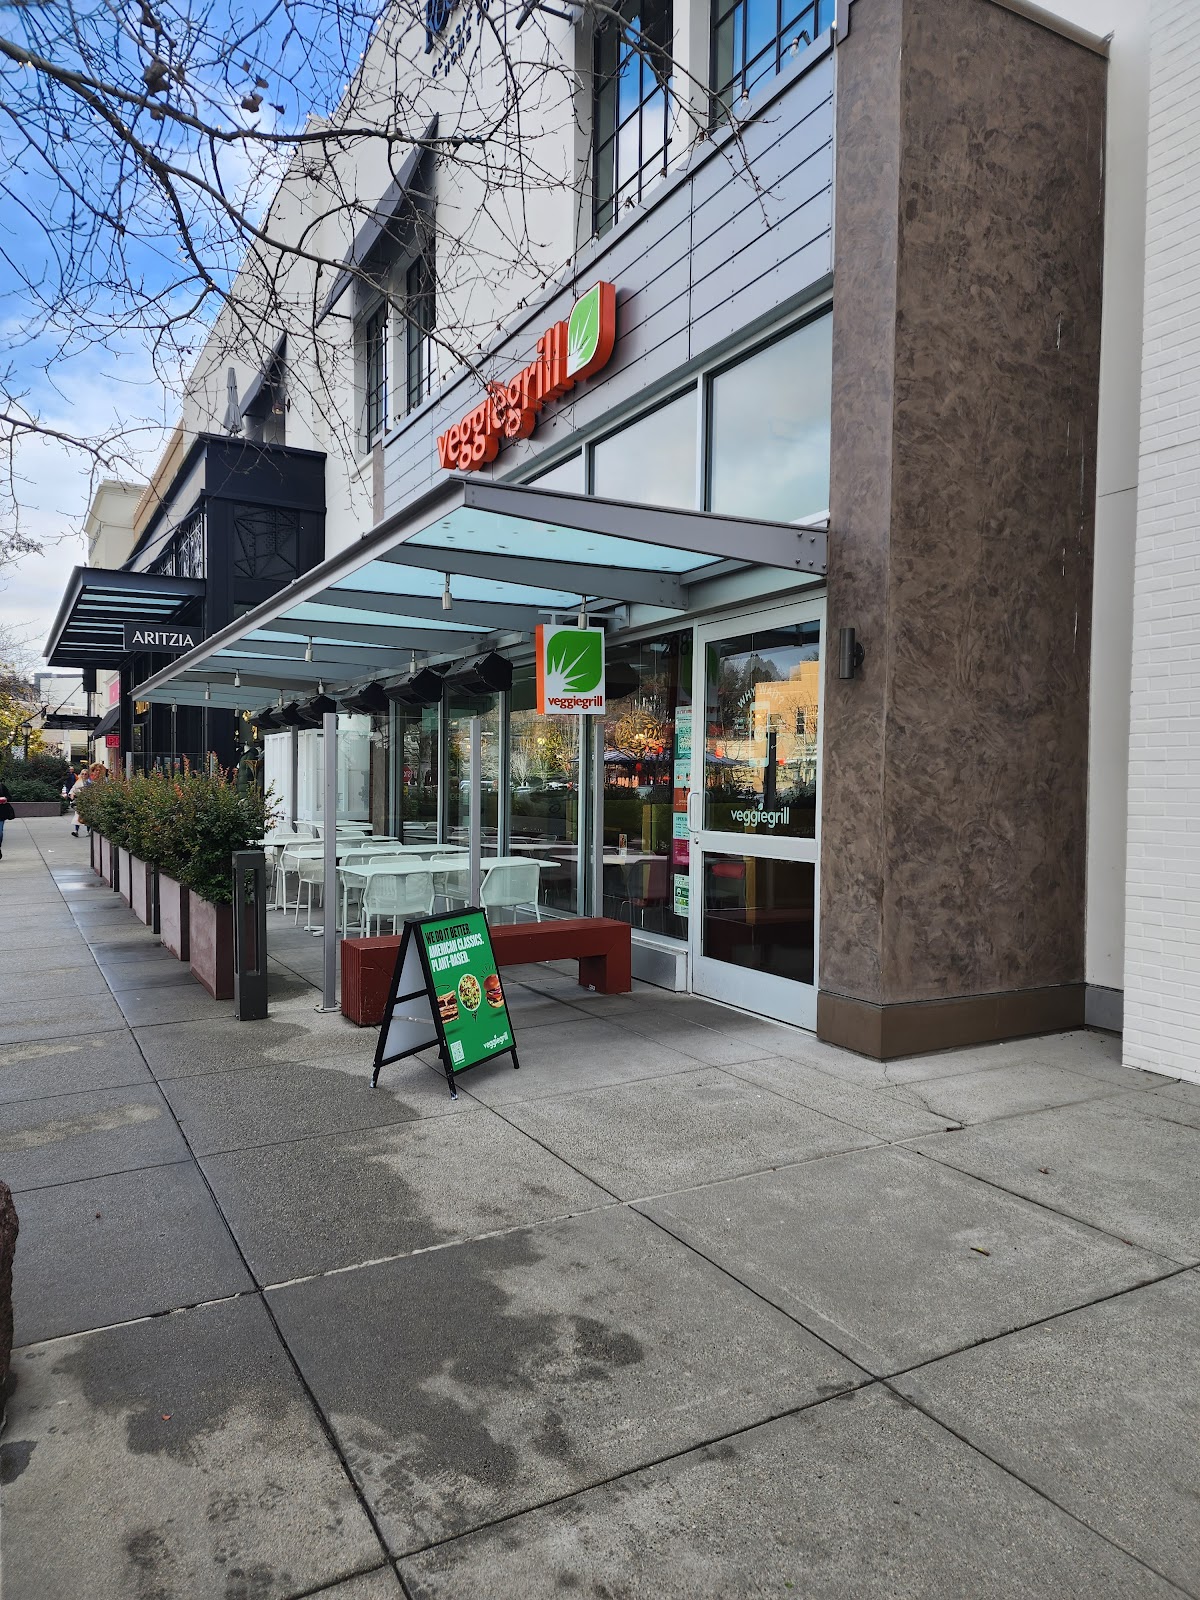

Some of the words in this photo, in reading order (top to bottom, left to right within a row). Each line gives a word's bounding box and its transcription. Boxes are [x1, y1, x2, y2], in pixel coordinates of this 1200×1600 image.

[437, 320, 571, 470] veggiegrill
[132, 631, 195, 647] ARITZIA
[548, 695, 603, 709] veggiegrill
[730, 805, 790, 828] veggiegrill
[425, 931, 435, 944] WE
[435, 929, 444, 942] DO
[443, 927, 450, 939] IT
[428, 939, 458, 959] AMERICAN
[457, 933, 485, 950] CLASSICS.
[483, 1031, 508, 1049] veggiegrill
